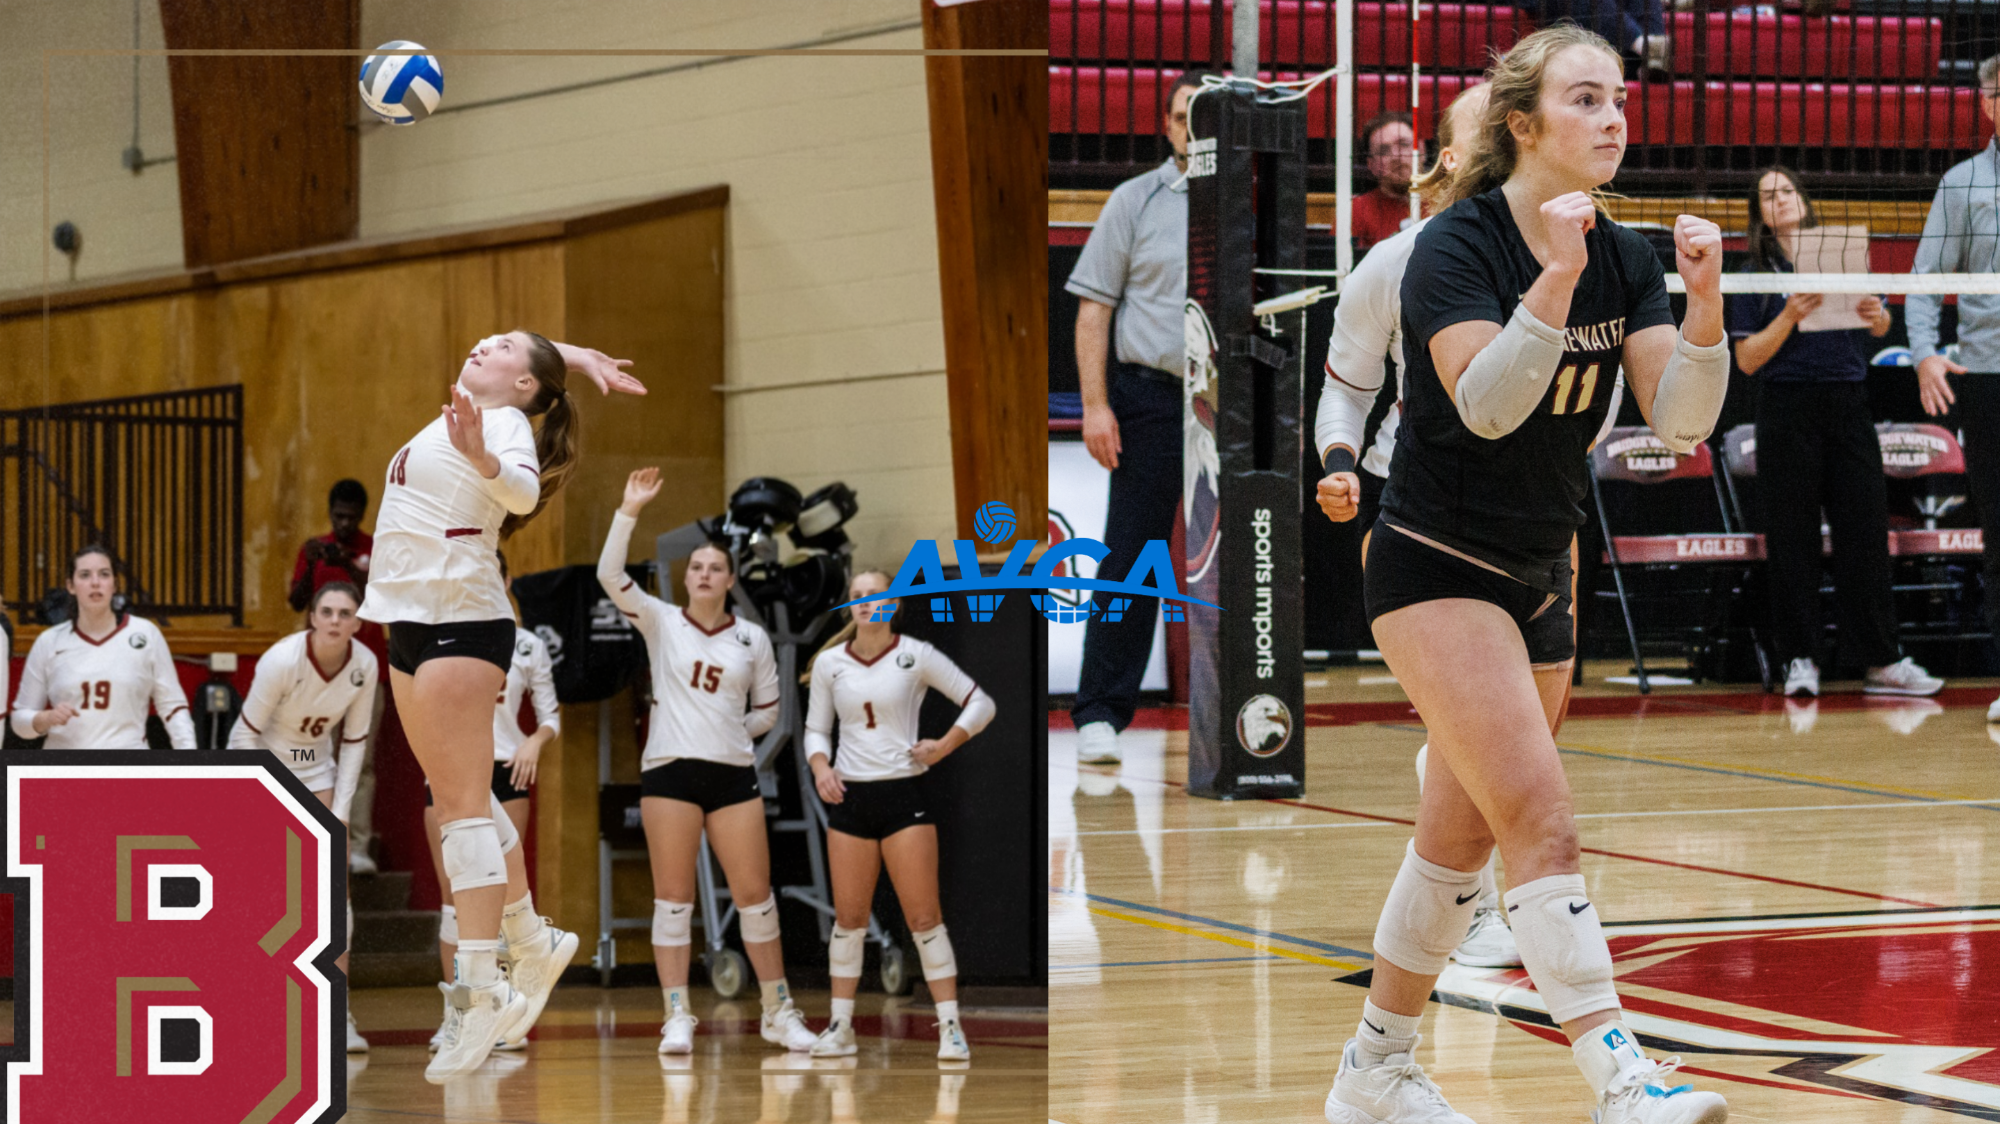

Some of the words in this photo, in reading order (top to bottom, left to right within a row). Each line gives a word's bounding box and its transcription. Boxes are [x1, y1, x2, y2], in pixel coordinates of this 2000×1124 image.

[1551, 363, 1600, 415] 11
[389, 447, 411, 486] 18
[1626, 457, 1677, 471] EAGLES
[1251, 508, 1275, 584] sports
[1677, 540, 1747, 556] EAGLES
[690, 660, 724, 694] 15
[80, 680, 111, 710] 19
[299, 716, 329, 738] 16
[863, 702, 877, 730] 1
